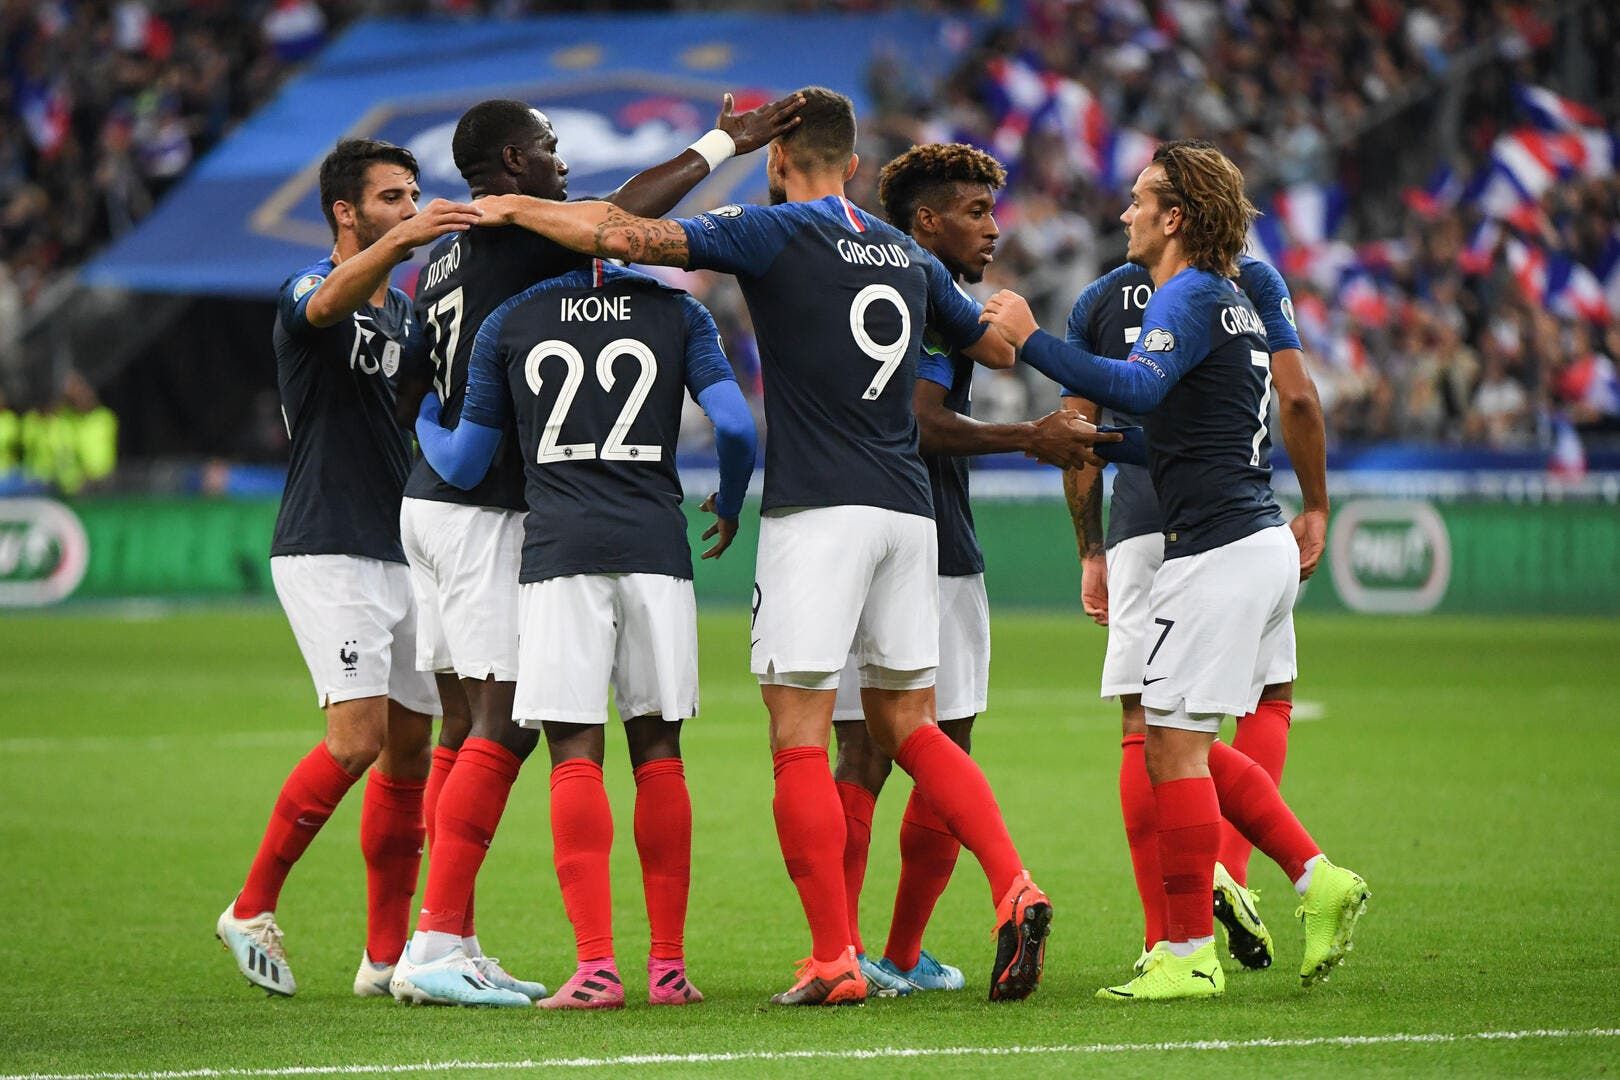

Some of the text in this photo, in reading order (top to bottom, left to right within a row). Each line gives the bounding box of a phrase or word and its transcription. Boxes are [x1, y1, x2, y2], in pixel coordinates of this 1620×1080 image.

[836, 238, 910, 269] GIROUD
[560, 296, 631, 322] IKONE
[1121, 284, 1157, 310] TO
[427, 285, 464, 407] 17
[849, 283, 911, 401] 9
[524, 338, 662, 464] 22
[1249, 349, 1273, 467] 7
[1146, 617, 1176, 666] 7
